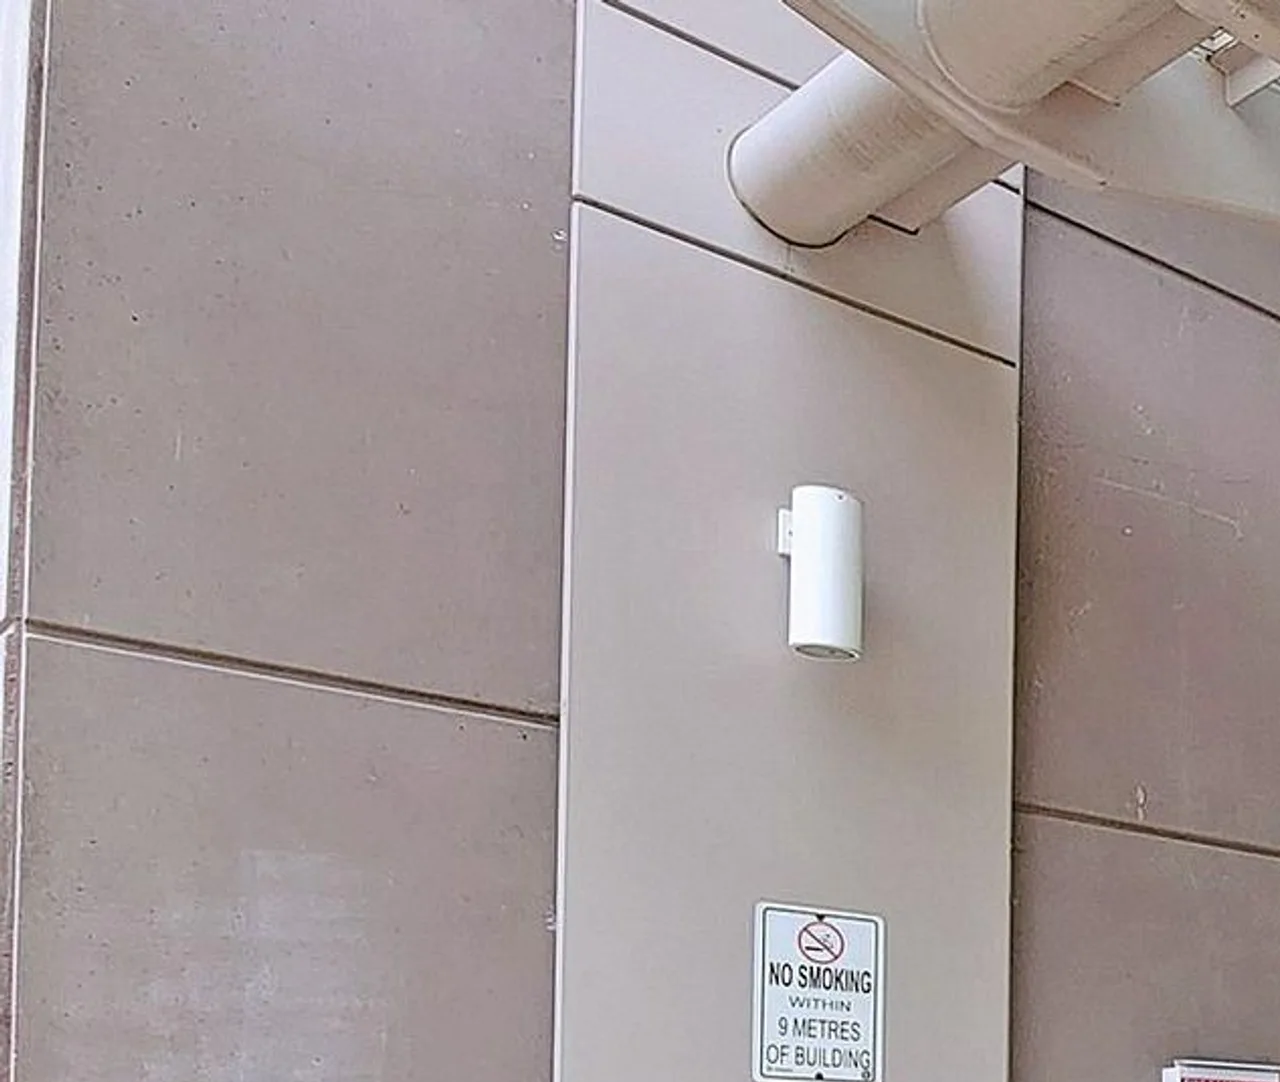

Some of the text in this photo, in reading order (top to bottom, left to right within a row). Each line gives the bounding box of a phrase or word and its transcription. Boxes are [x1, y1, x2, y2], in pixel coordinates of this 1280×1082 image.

[769, 962, 872, 994] NO SMOKING
[788, 995, 851, 1012] WITHIN
[778, 1016, 861, 1042] 9 METRES
[767, 1044, 870, 1070] OF BUILDING
